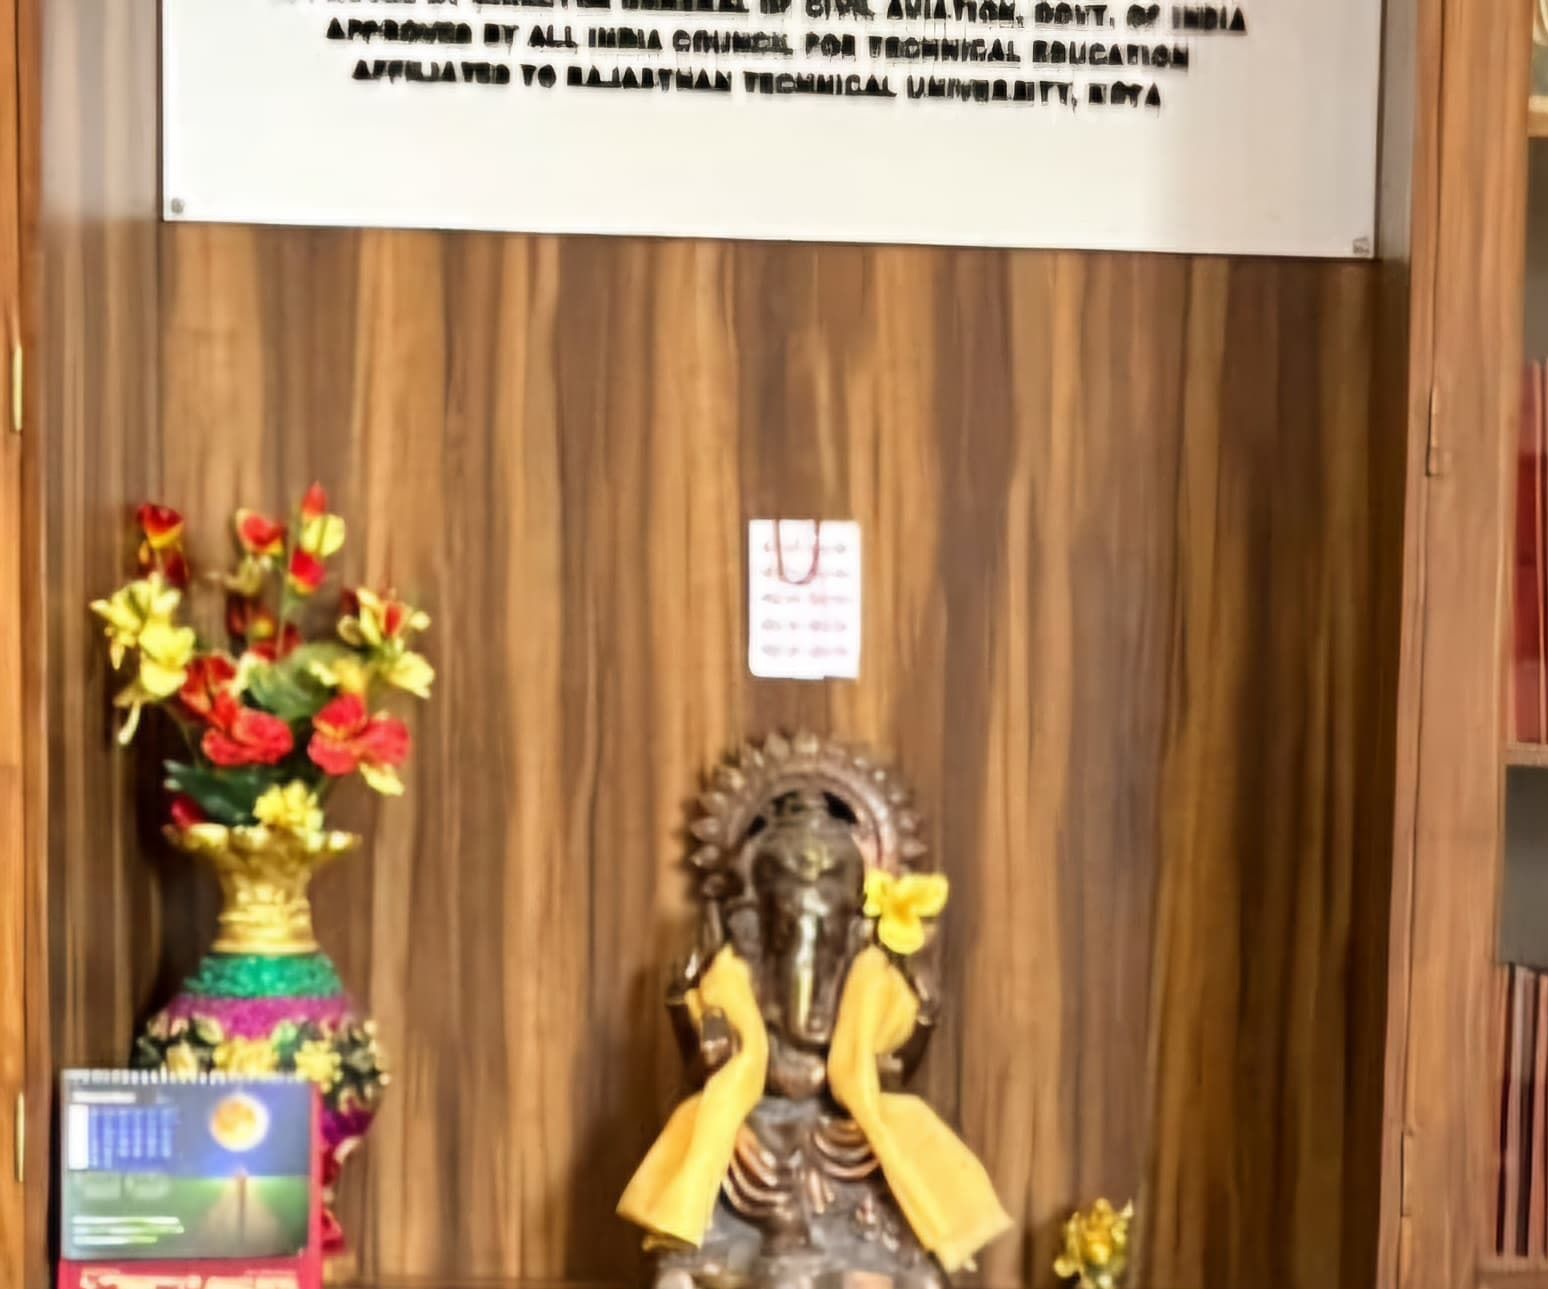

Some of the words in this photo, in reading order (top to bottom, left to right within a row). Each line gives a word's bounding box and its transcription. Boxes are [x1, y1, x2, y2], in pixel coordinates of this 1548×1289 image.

[1171, 6, 1246, 31] INDIA
[528, 24, 579, 48] ALL
[588, 26, 662, 50] INDIA
[806, 31, 855, 57] FOR
[869, 35, 1020, 63] TECHNICAL
[1032, 40, 1188, 68] EDUCATION
[521, 64, 556, 88] TO
[743, 71, 897, 96] TECHNICAL
